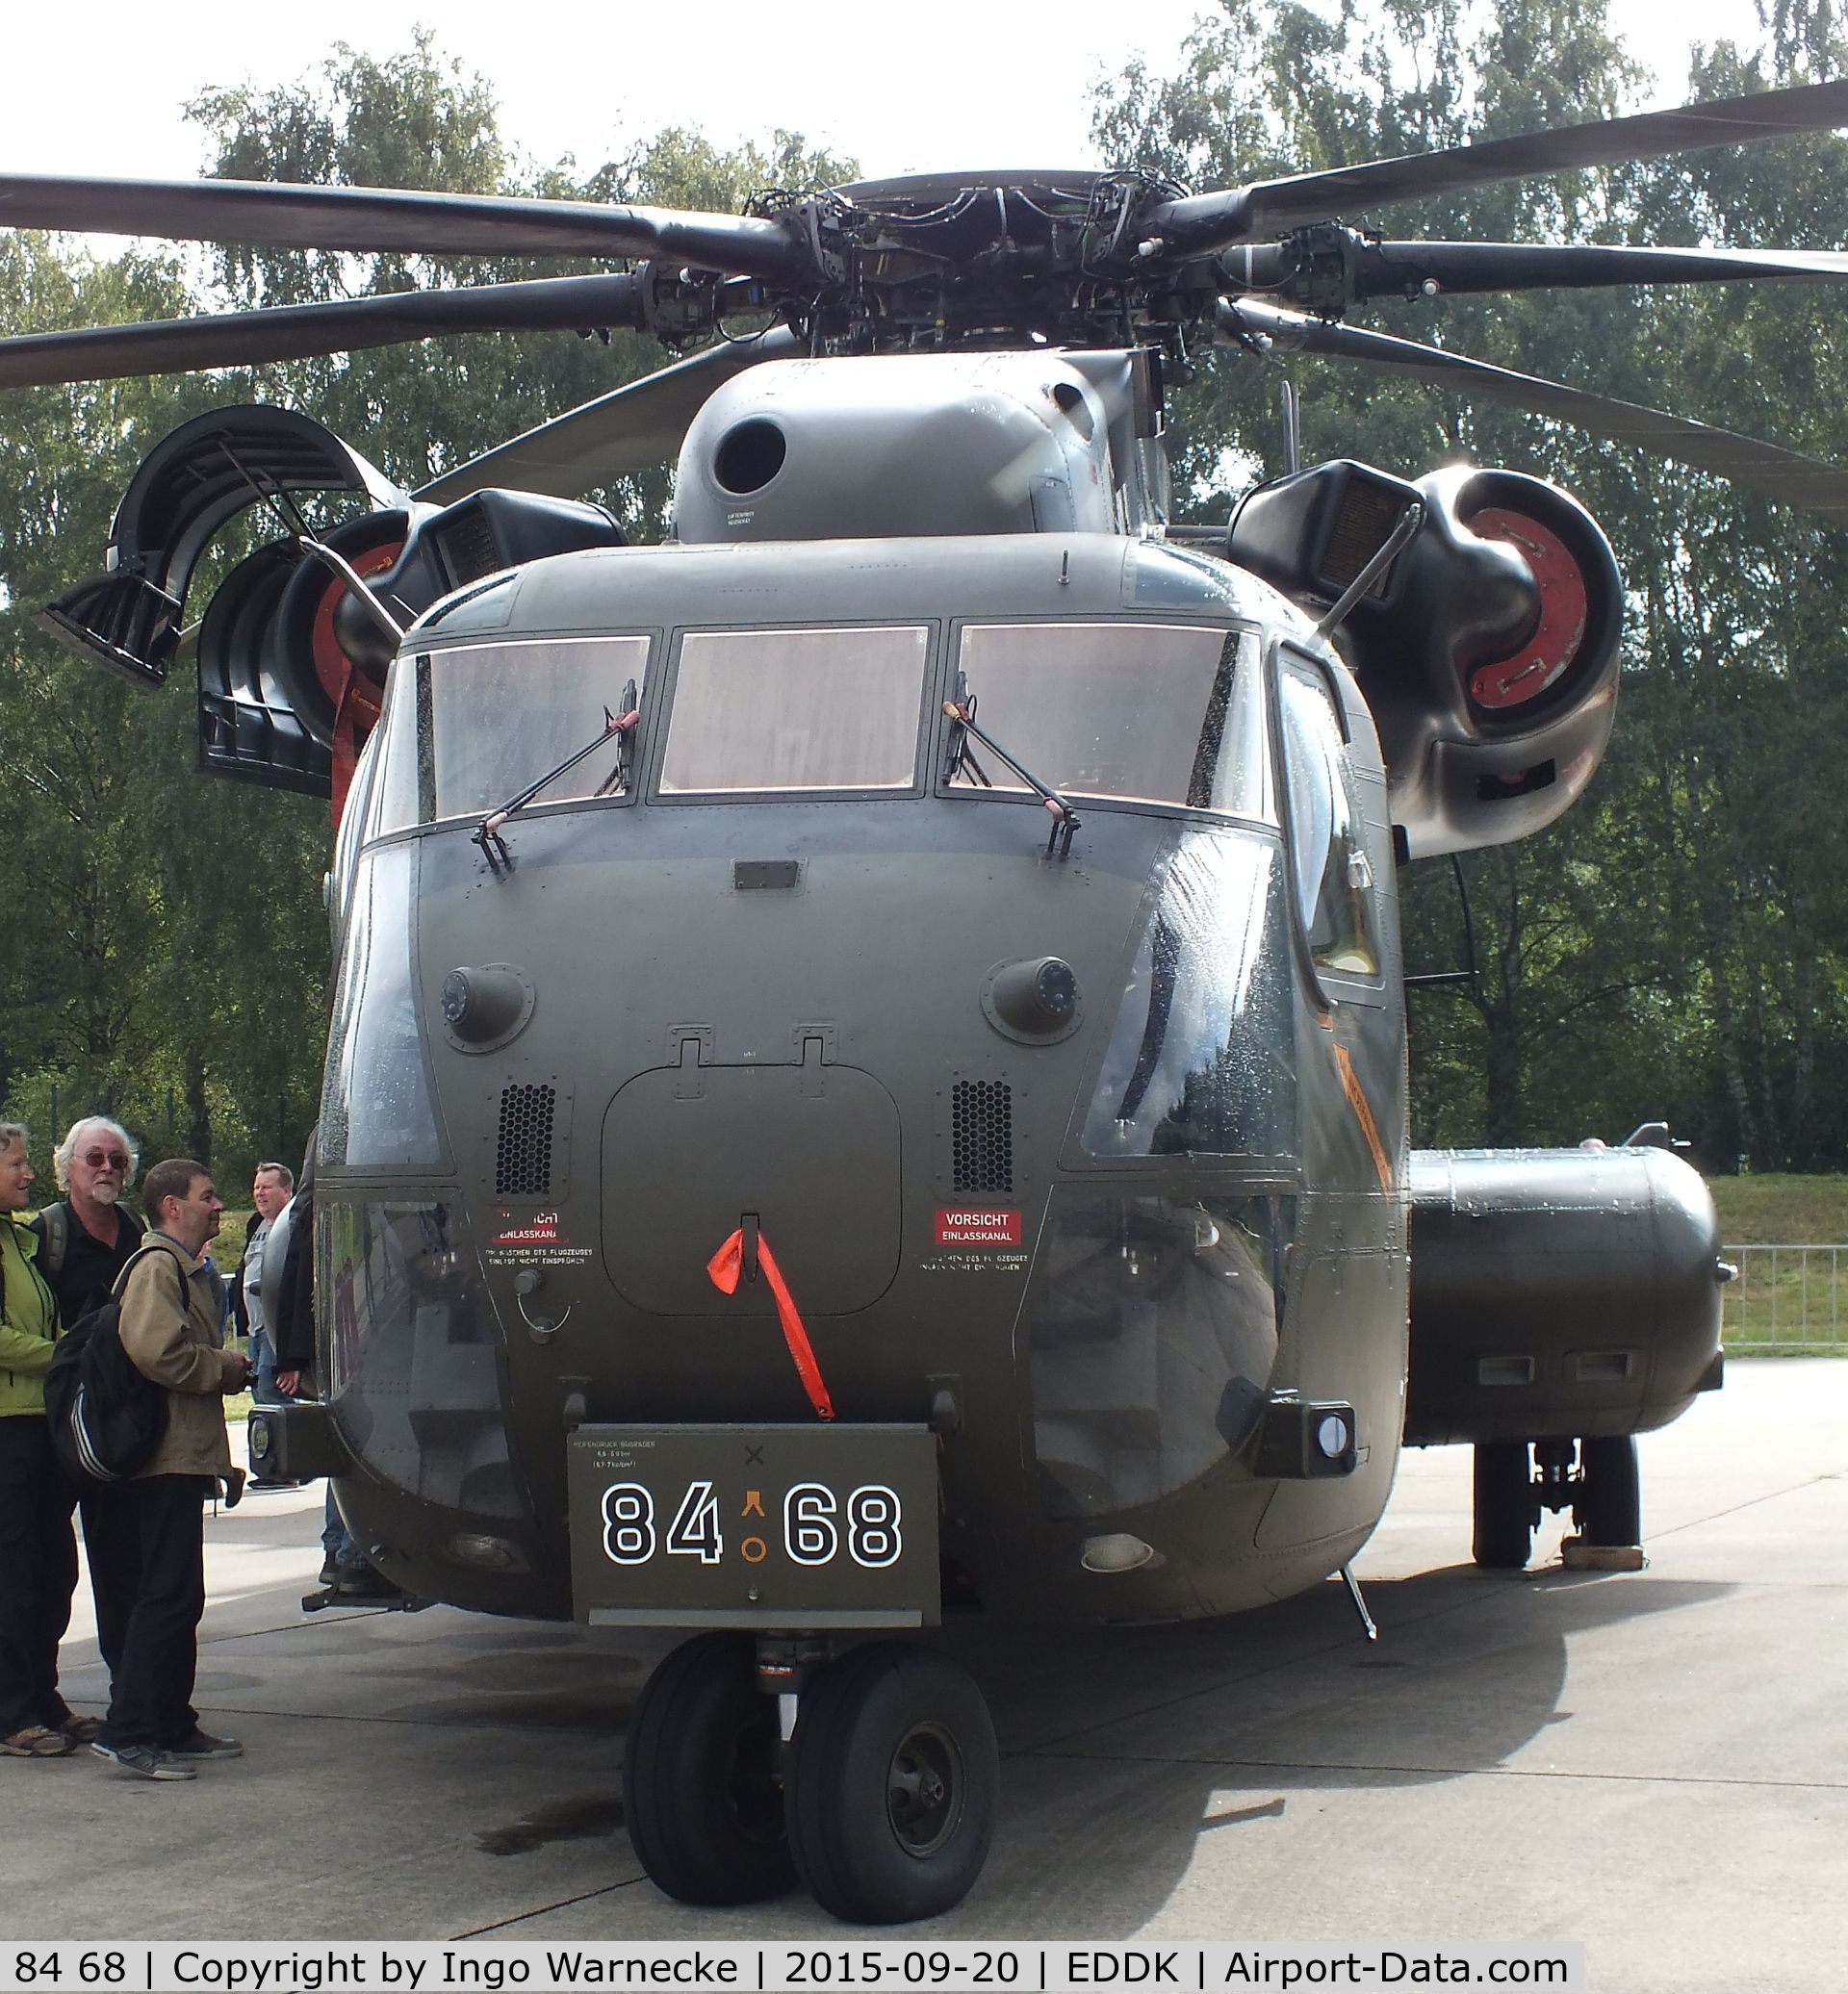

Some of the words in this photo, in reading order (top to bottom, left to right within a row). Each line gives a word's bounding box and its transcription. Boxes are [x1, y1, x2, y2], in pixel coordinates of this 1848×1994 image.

[946, 1214, 1009, 1226] VORSICHT
[942, 1232, 1013, 1241] EINLASSKANAL
[601, 1482, 724, 1565] 84
[783, 1482, 903, 1569] 68
